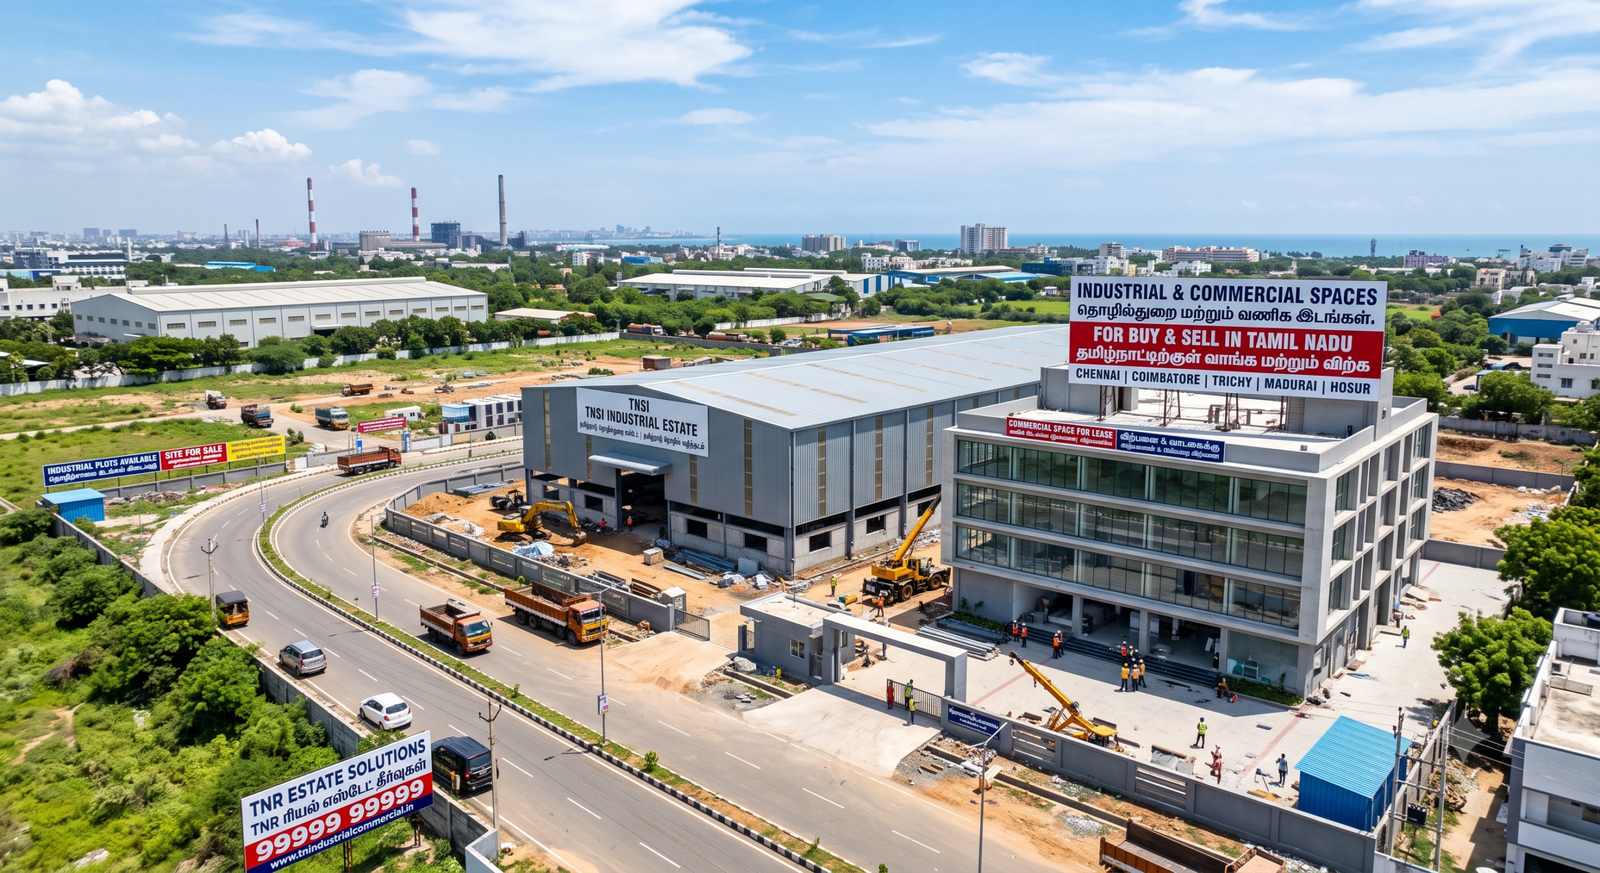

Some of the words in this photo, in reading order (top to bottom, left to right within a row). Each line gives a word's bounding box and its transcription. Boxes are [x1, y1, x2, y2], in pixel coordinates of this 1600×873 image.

[1078, 282, 1167, 300] INDUSTRIAL
[1173, 284, 1184, 301] &
[1190, 284, 1304, 304] COMMERCIAL
[1310, 287, 1378, 306] SPACES
[1077, 302, 1177, 321] தொழில்துறை
[1181, 305, 1234, 324] மற்றும்
[1238, 308, 1292, 323] வணிக
[1296, 308, 1375, 325] இடங்கள்.
[1093, 326, 1124, 342] FOR
[1128, 327, 1160, 344] BUY
[1164, 328, 1177, 345] &
[1182, 329, 1219, 347] SELL
[1225, 330, 1242, 348] IN
[1247, 331, 1299, 350] TAMIL
[1304, 333, 1353, 352] NADU
[1076, 345, 1201, 366] தமிழ்நாட்டிற்குள்
[1205, 351, 1257, 367] வாங்க
[1261, 353, 1319, 373] மற்றும்
[1323, 355, 1371, 375] விற்க
[1076, 368, 1120, 381] CHENNAI
[1132, 371, 1201, 385] COIMBATORE
[1212, 375, 1252, 388] TRICHY
[1264, 378, 1317, 391] MADURAI
[1330, 381, 1371, 395] HOSUR
[628, 398, 650, 413] TNSI
[585, 406, 604, 420] TNSI
[607, 410, 660, 430] INDUSTRIAL
[662, 419, 698, 437] ESTATE
[1008, 419, 1052, 432] COMMERCIAL
[1053, 425, 1075, 435] SPACE
[1076, 427, 1090, 436] FOR
[1091, 429, 1113, 439] LEASE
[165, 450, 183, 460] SITE
[185, 447, 201, 457] FOR
[203, 445, 223, 455] SALE
[1160, 437, 1167, 446] &
[47, 463, 93, 475] INDUSTRIAL
[95, 459, 118, 469] PLOTS
[120, 454, 157, 466] AVAILABLE
[249, 792, 283, 817] TNR
[288, 769, 344, 804] ESTATE
[348, 739, 426, 780] SOLUTIONS
[250, 816, 280, 836] TNR
[283, 801, 320, 824] ரியல்
[323, 780, 374, 809] எஸ்டேட்
[376, 757, 427, 791] தீர்வுகள்
[255, 812, 341, 862] 99999
[350, 779, 424, 823] 99999
[270, 803, 414, 870] www.tnindustrialcommercial.in
